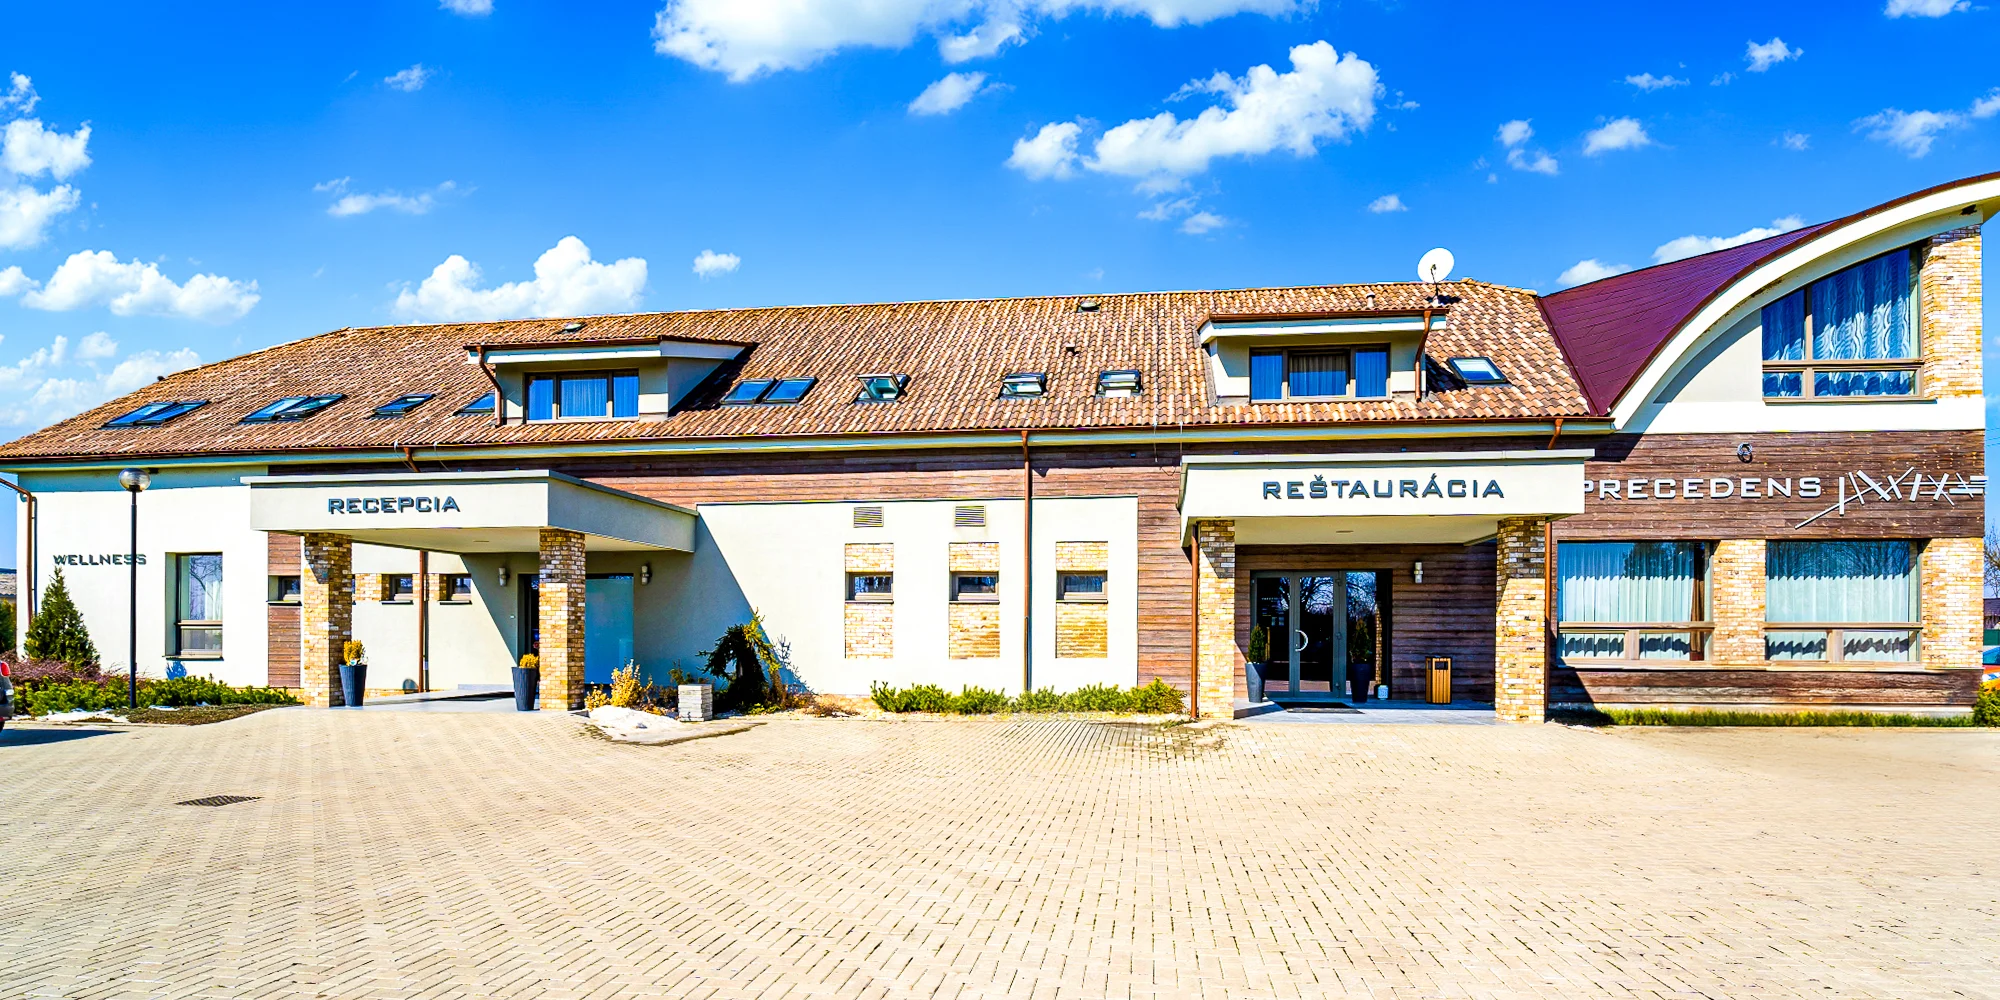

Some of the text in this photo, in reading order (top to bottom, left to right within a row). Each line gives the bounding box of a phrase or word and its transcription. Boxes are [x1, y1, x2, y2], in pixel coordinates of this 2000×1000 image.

[1262, 474, 1505, 500] REŠTAURÁCIA
[327, 496, 461, 514] RECEPCIA
[53, 553, 147, 566] WELLNESS
